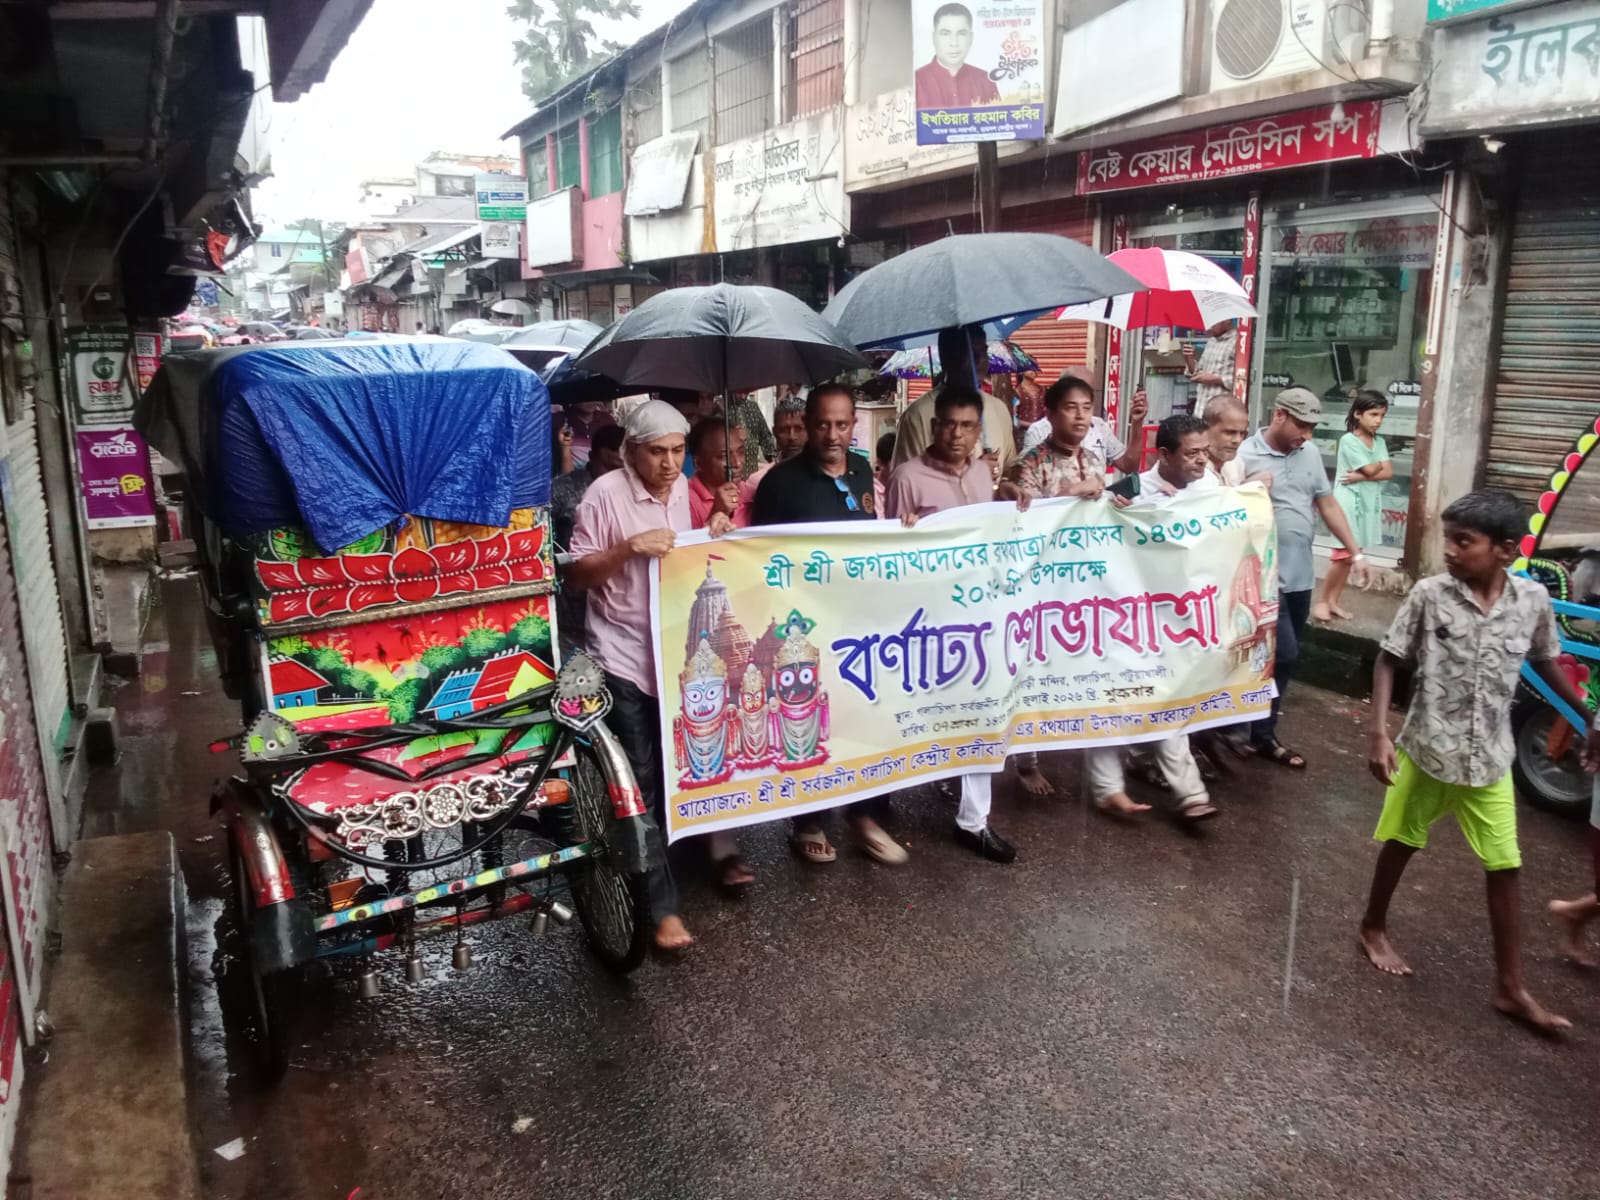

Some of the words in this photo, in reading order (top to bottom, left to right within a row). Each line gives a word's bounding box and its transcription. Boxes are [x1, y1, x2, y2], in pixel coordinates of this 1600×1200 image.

[972, 109, 1008, 124] রহমান
[1011, 105, 1041, 120] কবির
[1088, 149, 1123, 184] বেষ্ট
[1129, 144, 1195, 178] কেয়ার
[1202, 121, 1305, 168] মেডিসিন
[1313, 111, 1364, 148] সপ
[763, 554, 794, 590] শ্রী
[804, 550, 834, 585] শ্রী
[843, 543, 988, 581] জগন্নাথদেবের
[1134, 518, 1203, 546] ১৪৩৩
[1030, 560, 1107, 586] উপলক্ষে
[831, 607, 992, 702] বর্ণাঢ্য
[1004, 584, 1219, 678] শোভাযাত্রা
[1103, 684, 1155, 704] শুক্রবার
[677, 792, 752, 819] আয়োজনে:
[757, 779, 774, 804] শ্রী
[779, 776, 797, 800] শ্রী
[801, 767, 857, 794] সর্বজনীন
[860, 755, 906, 783] গলাচিপা
[1016, 722, 1034, 737] এর
[1039, 717, 1086, 737] রথযাত্রা
